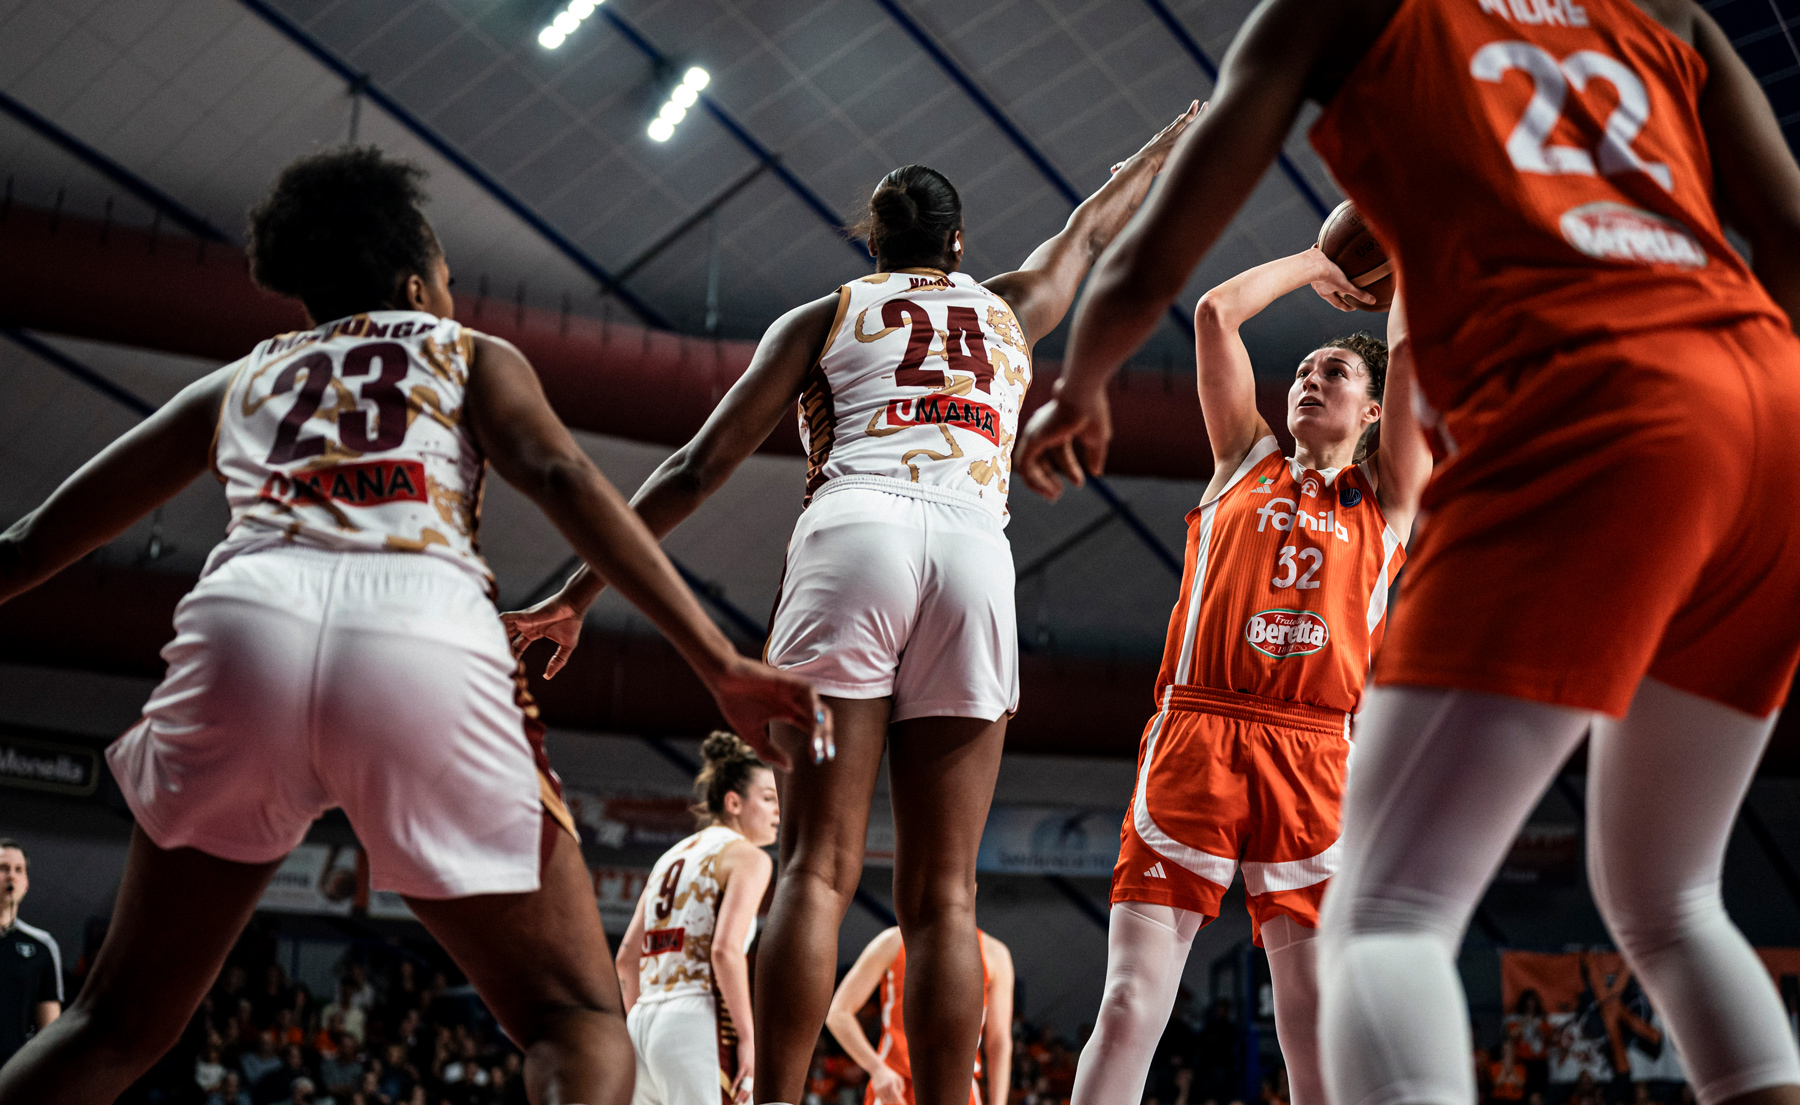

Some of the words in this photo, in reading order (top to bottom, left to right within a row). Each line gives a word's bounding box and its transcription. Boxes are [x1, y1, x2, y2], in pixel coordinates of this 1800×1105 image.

[1470, 40, 1674, 193] 22
[881, 299, 995, 395] 24
[266, 341, 409, 465] 23
[895, 397, 996, 438] UMANA
[1256, 497, 1349, 543] famila
[1271, 545, 1324, 590] 32
[1248, 616, 1325, 647] Beretta
[656, 858, 686, 921] 9
